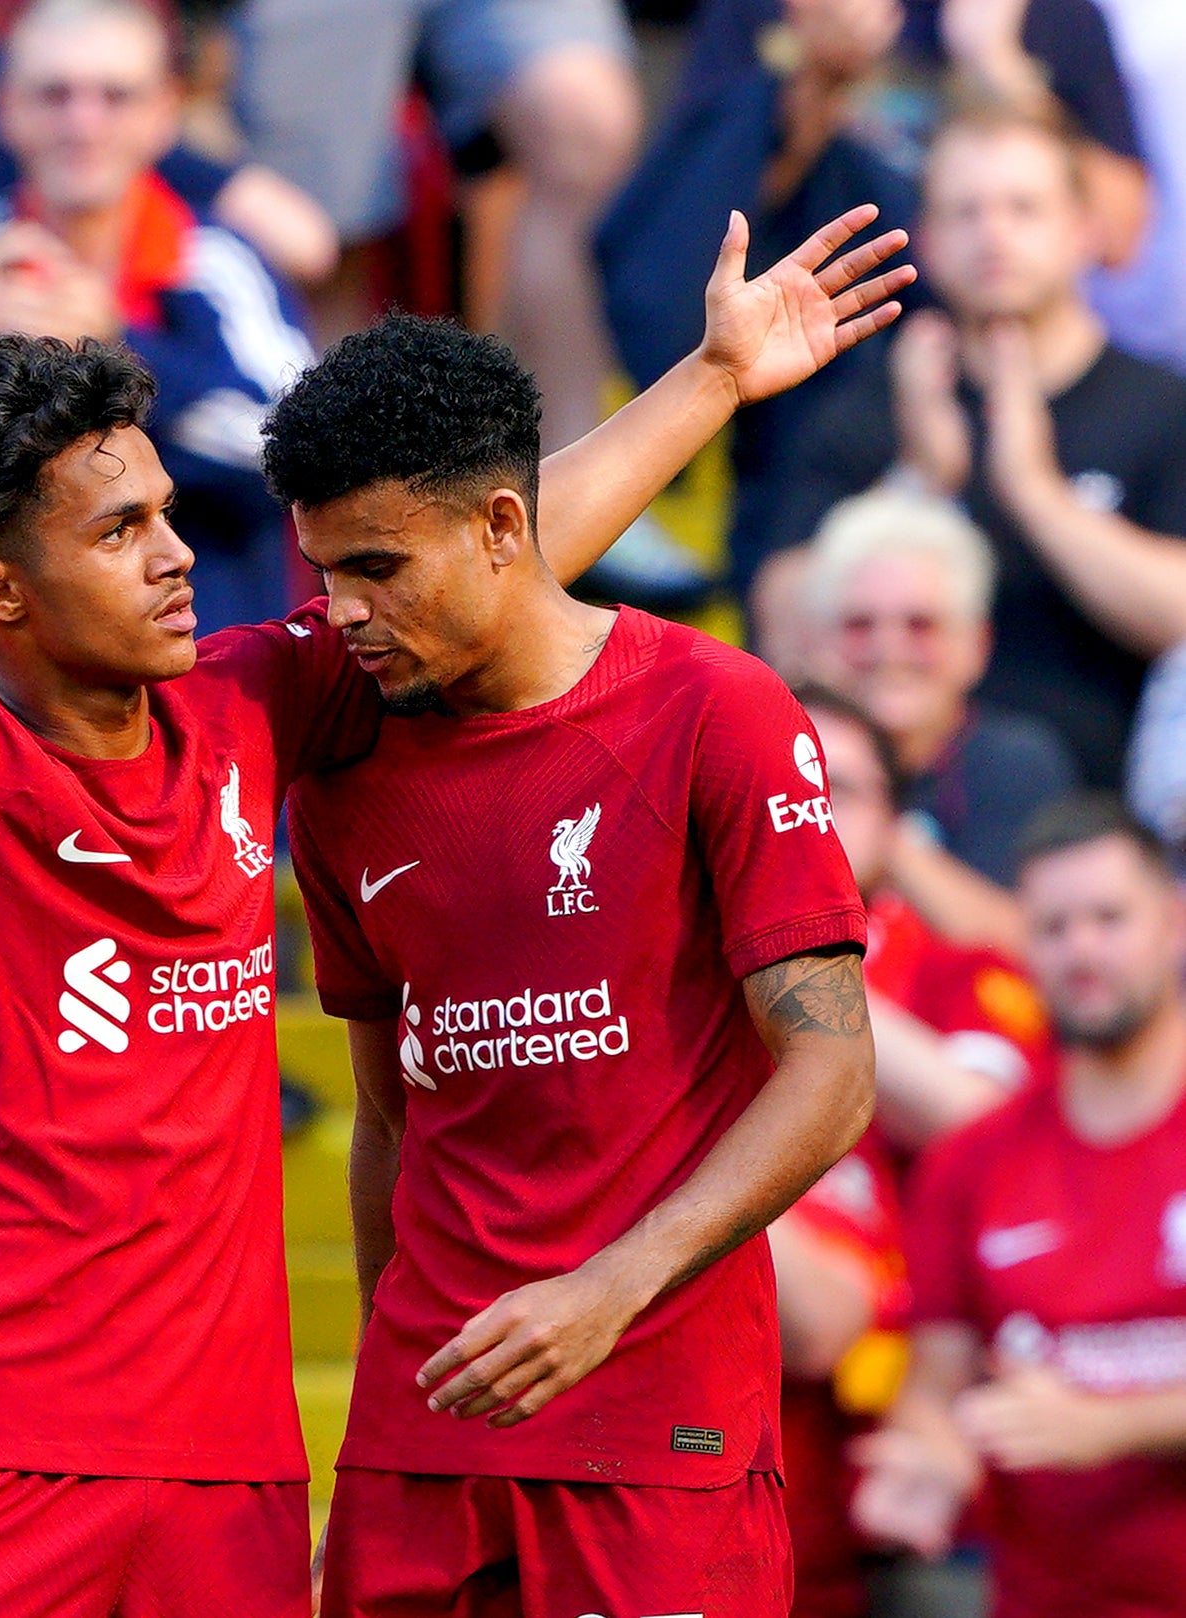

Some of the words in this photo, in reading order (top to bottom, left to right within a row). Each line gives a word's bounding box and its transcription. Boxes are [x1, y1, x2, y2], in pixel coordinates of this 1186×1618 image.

[767, 792, 835, 835] Exp
[546, 890, 600, 917] L.F.C.
[149, 934, 273, 994] stanard
[432, 978, 611, 1036] standard
[434, 1015, 629, 1074] chartered
